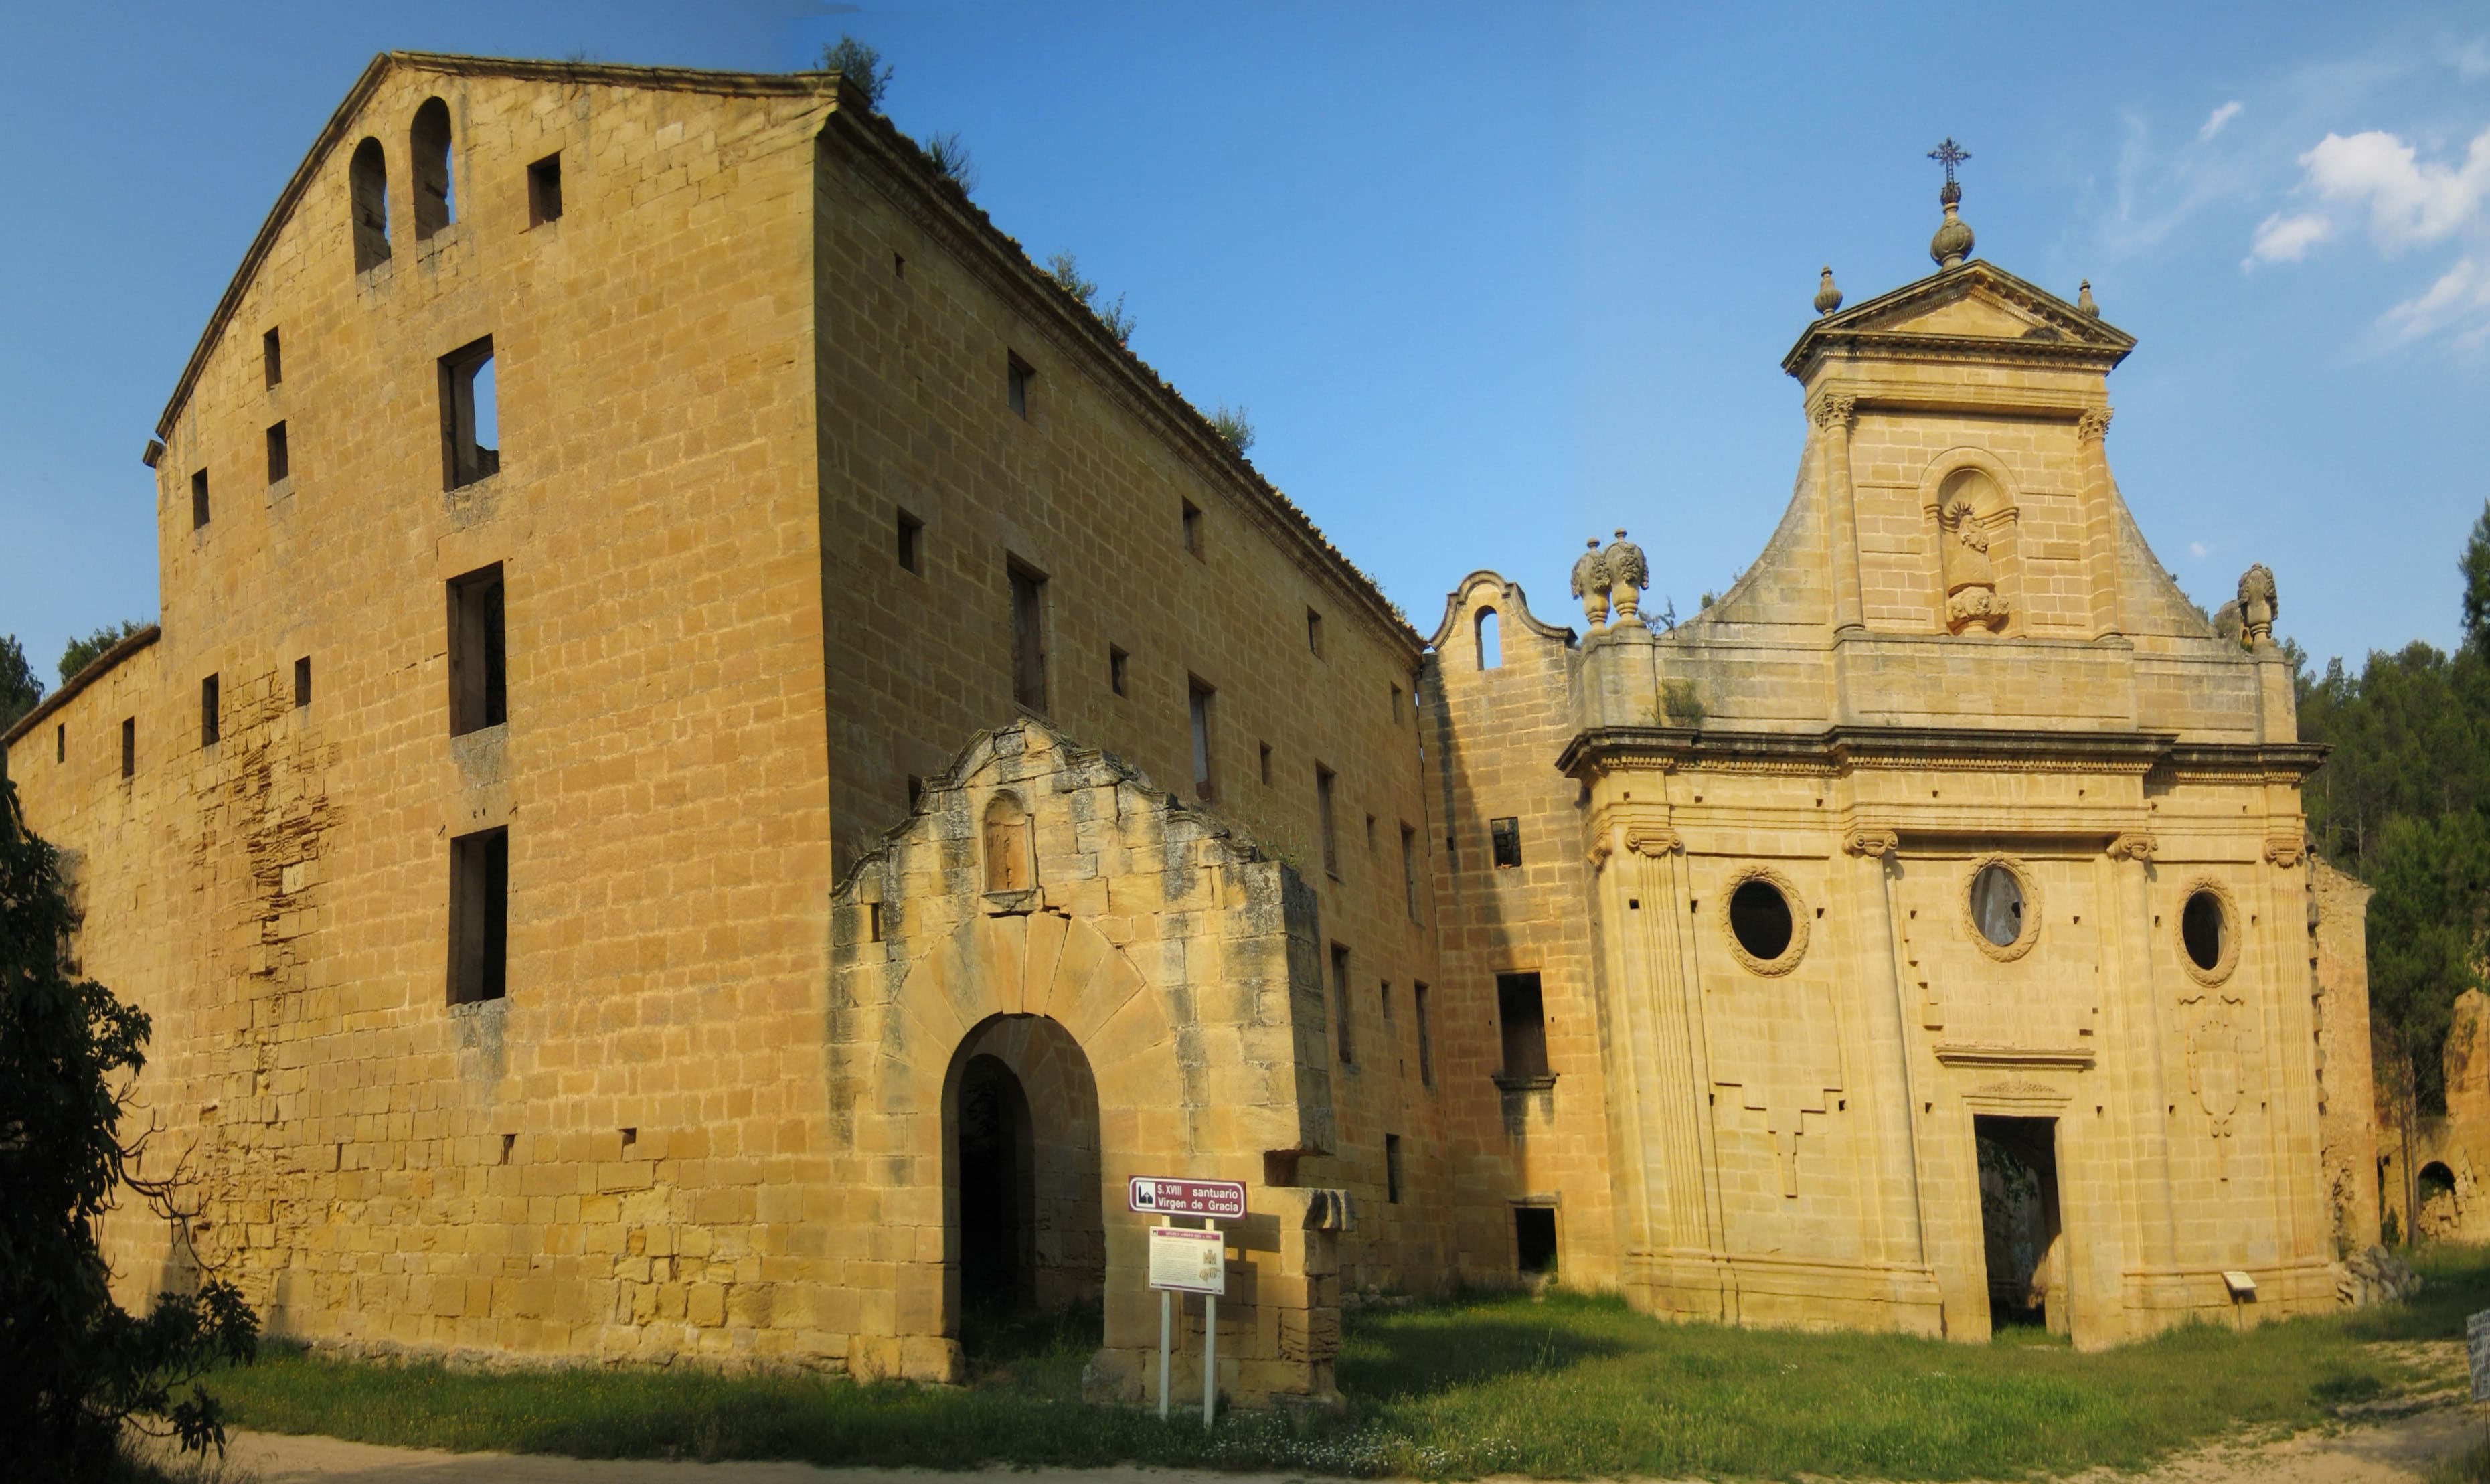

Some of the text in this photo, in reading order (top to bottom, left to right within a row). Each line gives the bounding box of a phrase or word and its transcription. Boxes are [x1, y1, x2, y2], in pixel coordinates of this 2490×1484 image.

[1157, 1185, 1238, 1199] S. XVIII santuario
[1157, 1197, 1238, 1212] Virgen de Gracia
